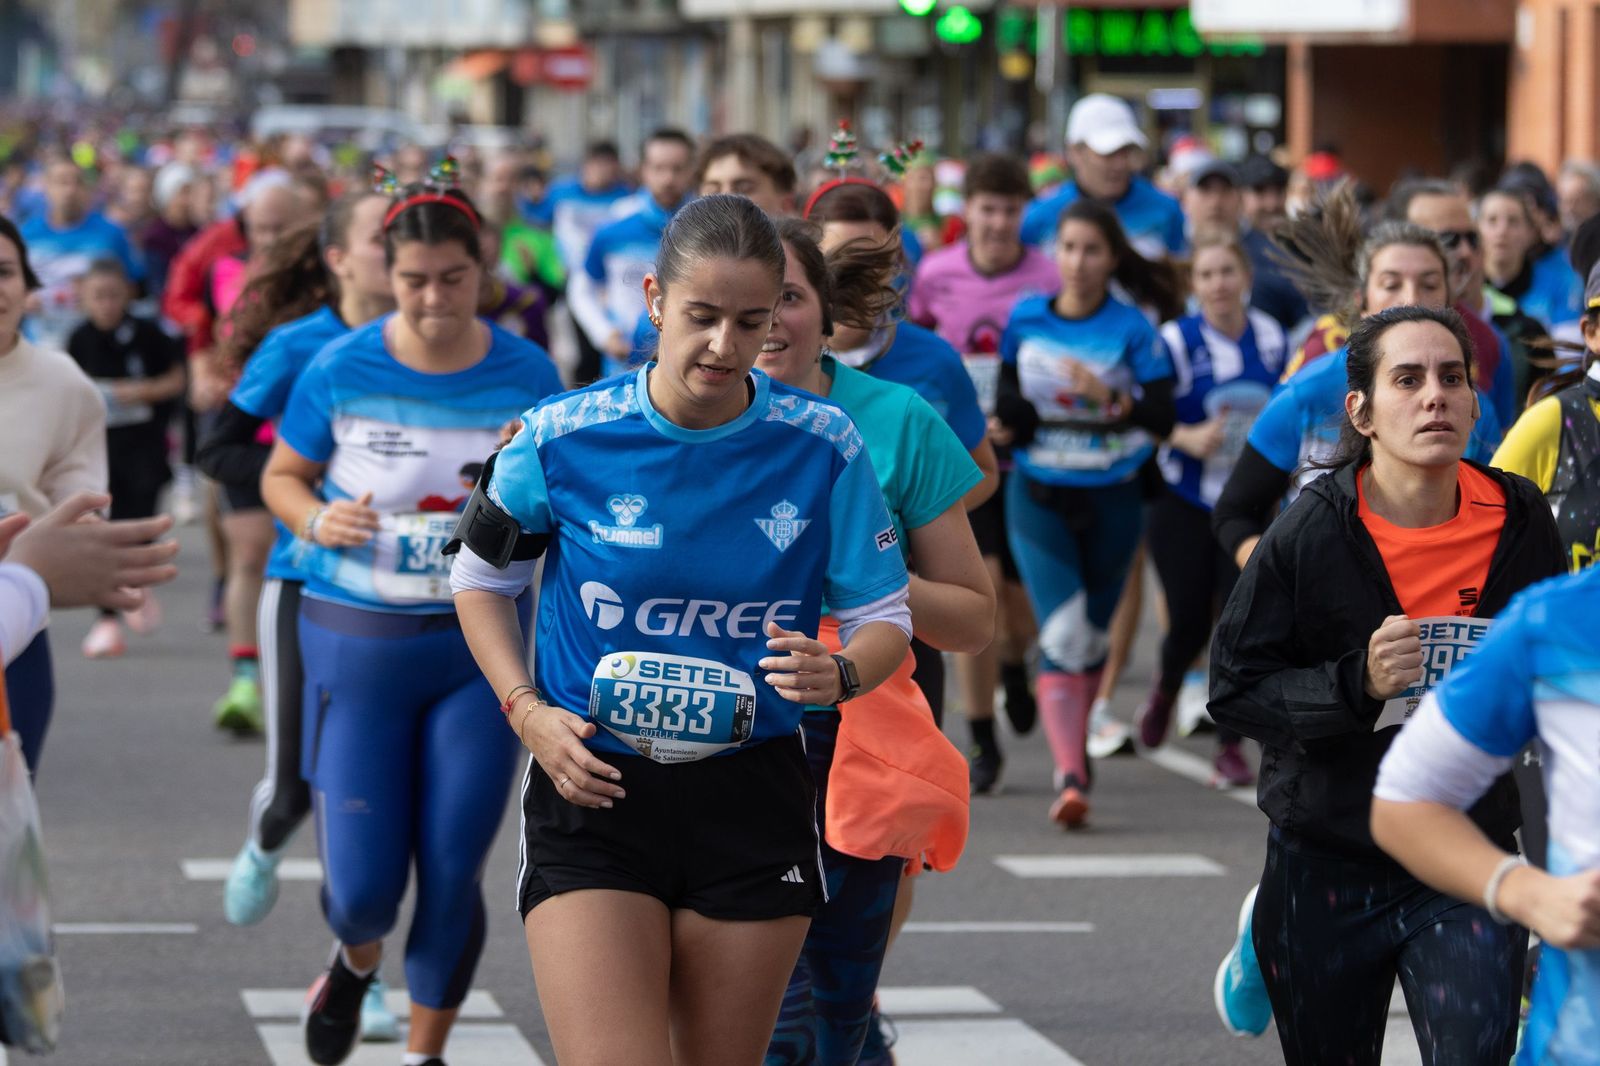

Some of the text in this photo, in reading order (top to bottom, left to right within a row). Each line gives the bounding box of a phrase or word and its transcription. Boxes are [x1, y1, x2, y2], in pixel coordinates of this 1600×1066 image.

[589, 521, 661, 546] hummel
[407, 536, 453, 572] 34
[635, 598, 802, 638] GREE
[1418, 622, 1488, 641] SETE
[638, 660, 741, 689] SETEL
[610, 682, 716, 735] 3333
[639, 728, 679, 740] GUILLE
[654, 747, 698, 755] Ayuntamiento
